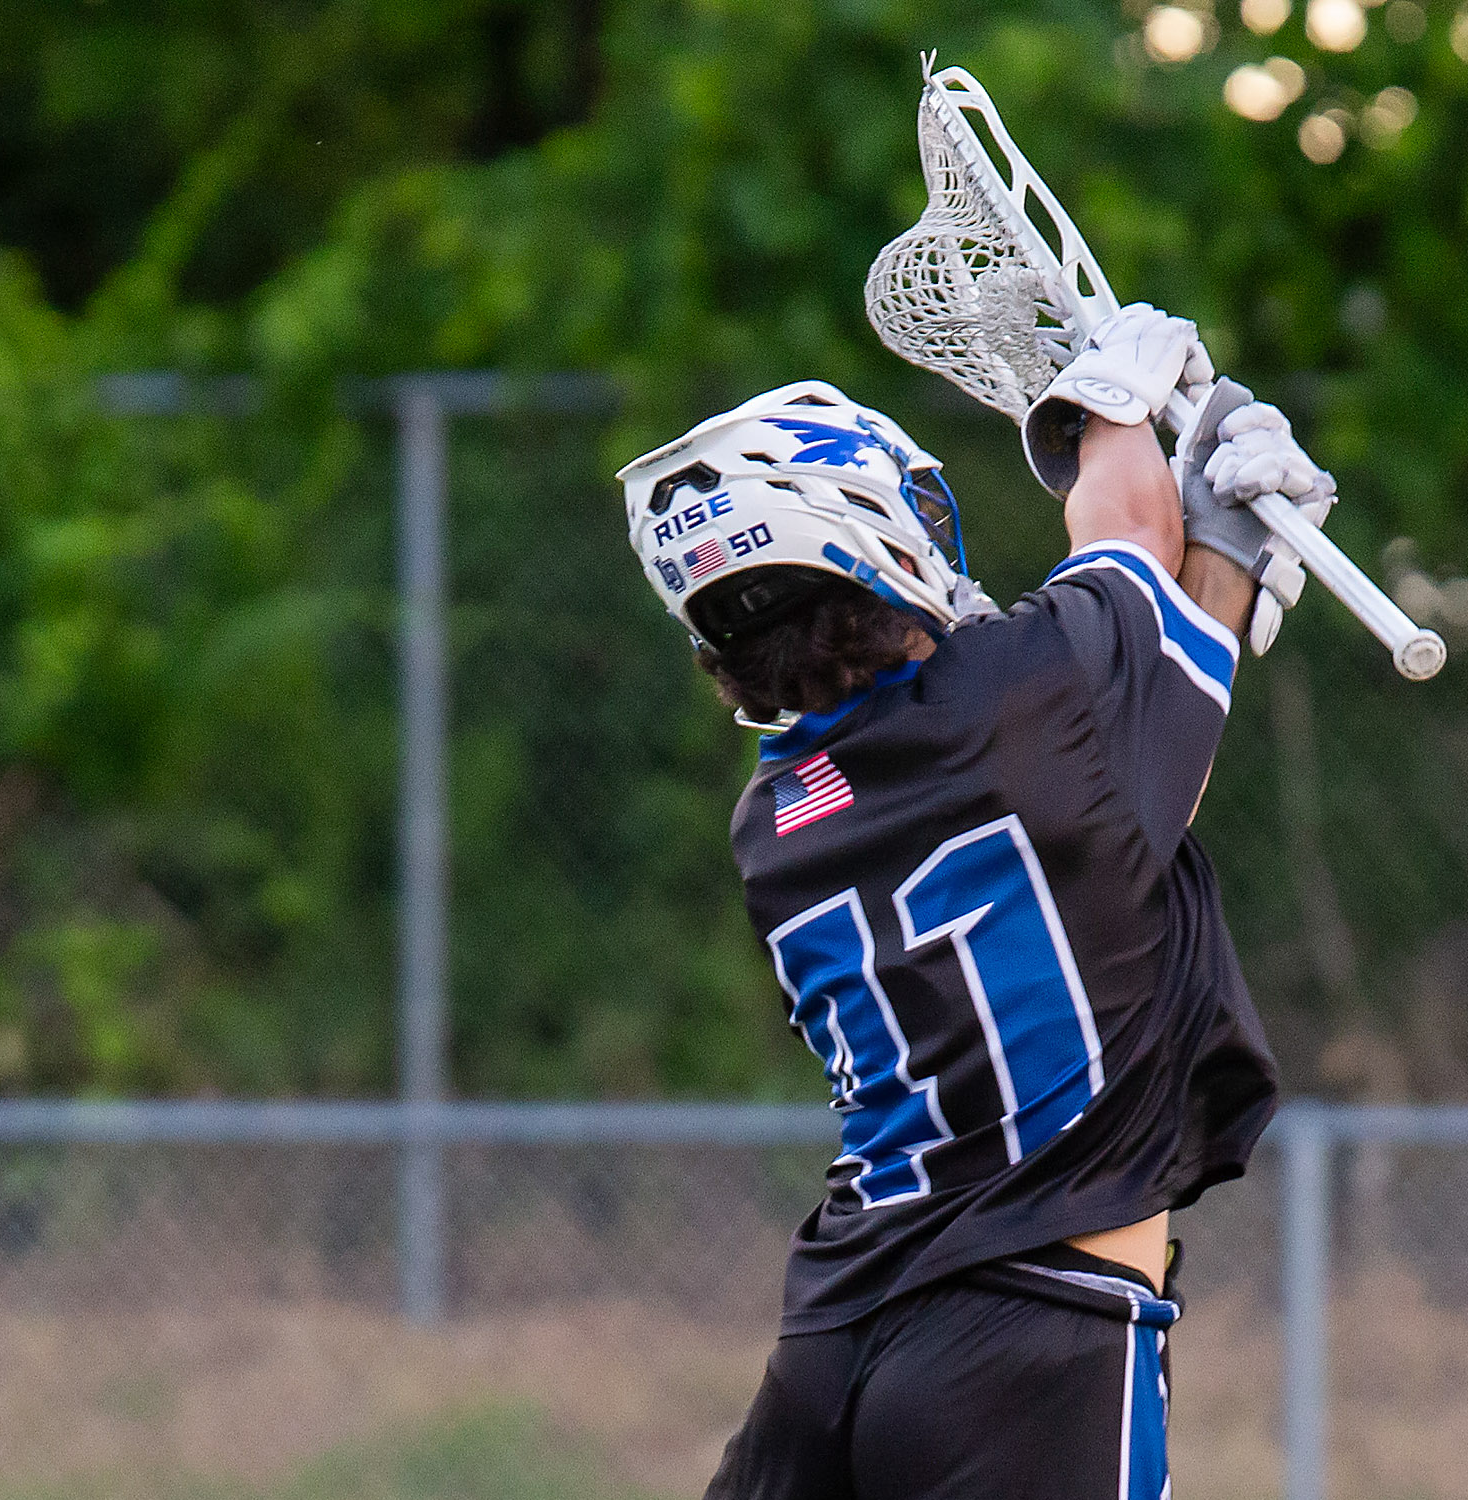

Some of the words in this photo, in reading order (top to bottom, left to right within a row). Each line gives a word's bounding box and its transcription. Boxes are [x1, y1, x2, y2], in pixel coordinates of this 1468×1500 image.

[653, 491, 734, 547] RISE
[727, 521, 774, 557] 50
[767, 813, 1105, 1210] 41
